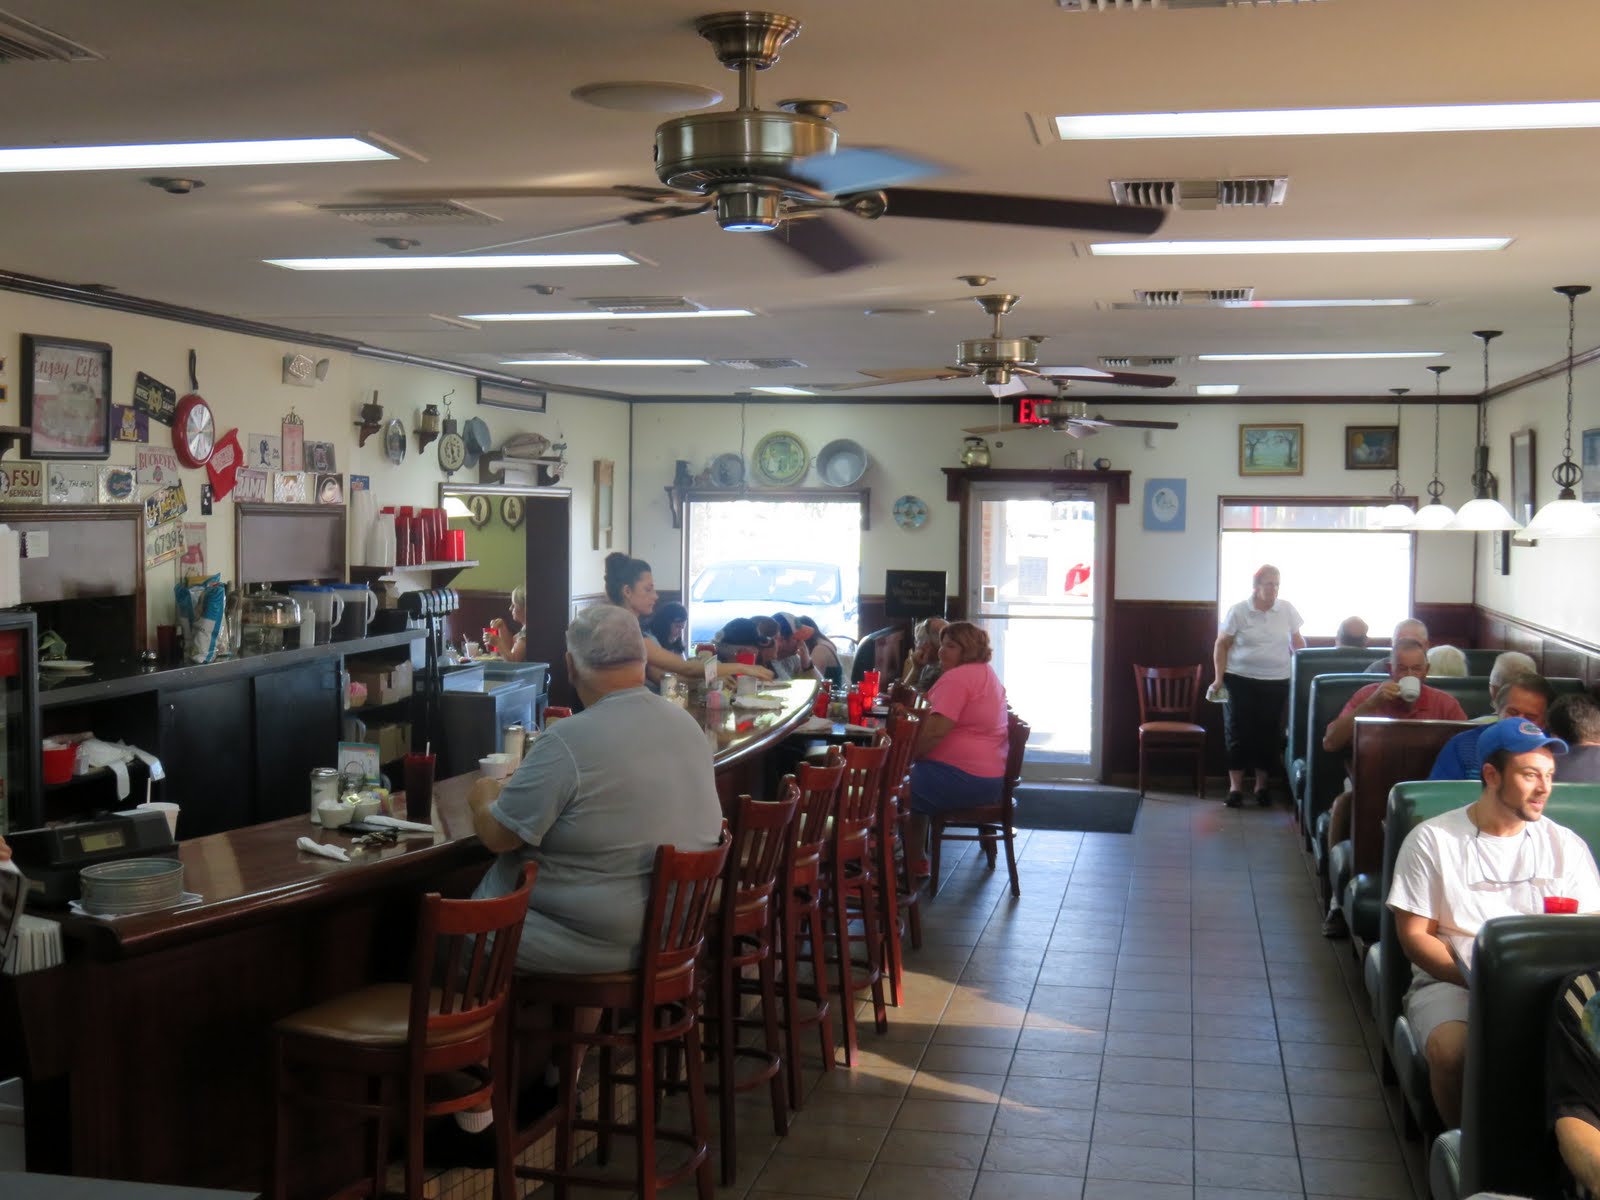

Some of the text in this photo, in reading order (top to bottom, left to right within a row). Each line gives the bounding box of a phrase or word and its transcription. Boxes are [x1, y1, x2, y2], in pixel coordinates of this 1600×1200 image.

[33, 352, 69, 380] Enjoy
[1020, 399, 1053, 424] EX
[138, 452, 177, 471] BUCKEYES
[12, 469, 40, 487] FSU
[236, 476, 267, 498] BAMA
[9, 489, 42, 498] SEMINOLES
